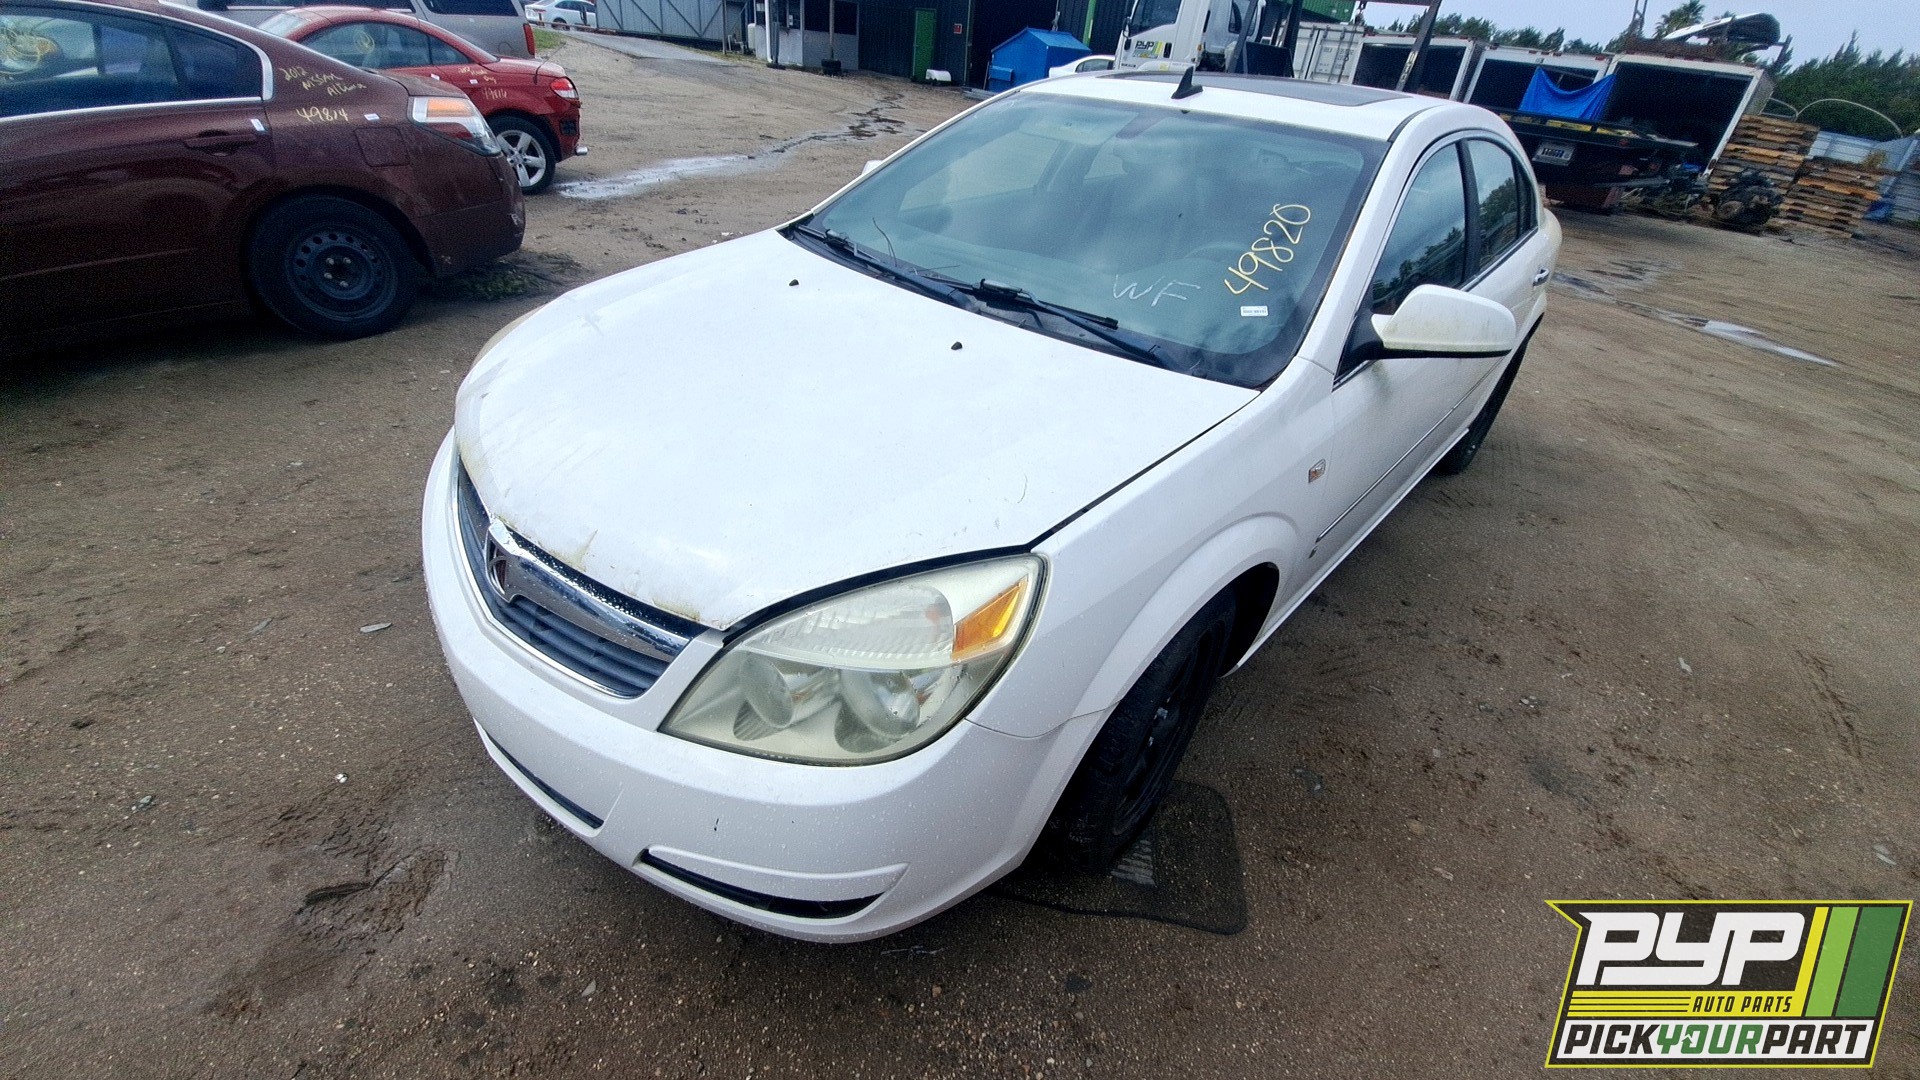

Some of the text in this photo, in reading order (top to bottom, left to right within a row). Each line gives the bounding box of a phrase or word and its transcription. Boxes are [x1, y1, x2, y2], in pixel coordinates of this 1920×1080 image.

[280, 66, 308, 81] 2012
[296, 106, 349, 122] 49814
[1224, 203, 1311, 295] 49820
[1113, 274, 1201, 307] WF
